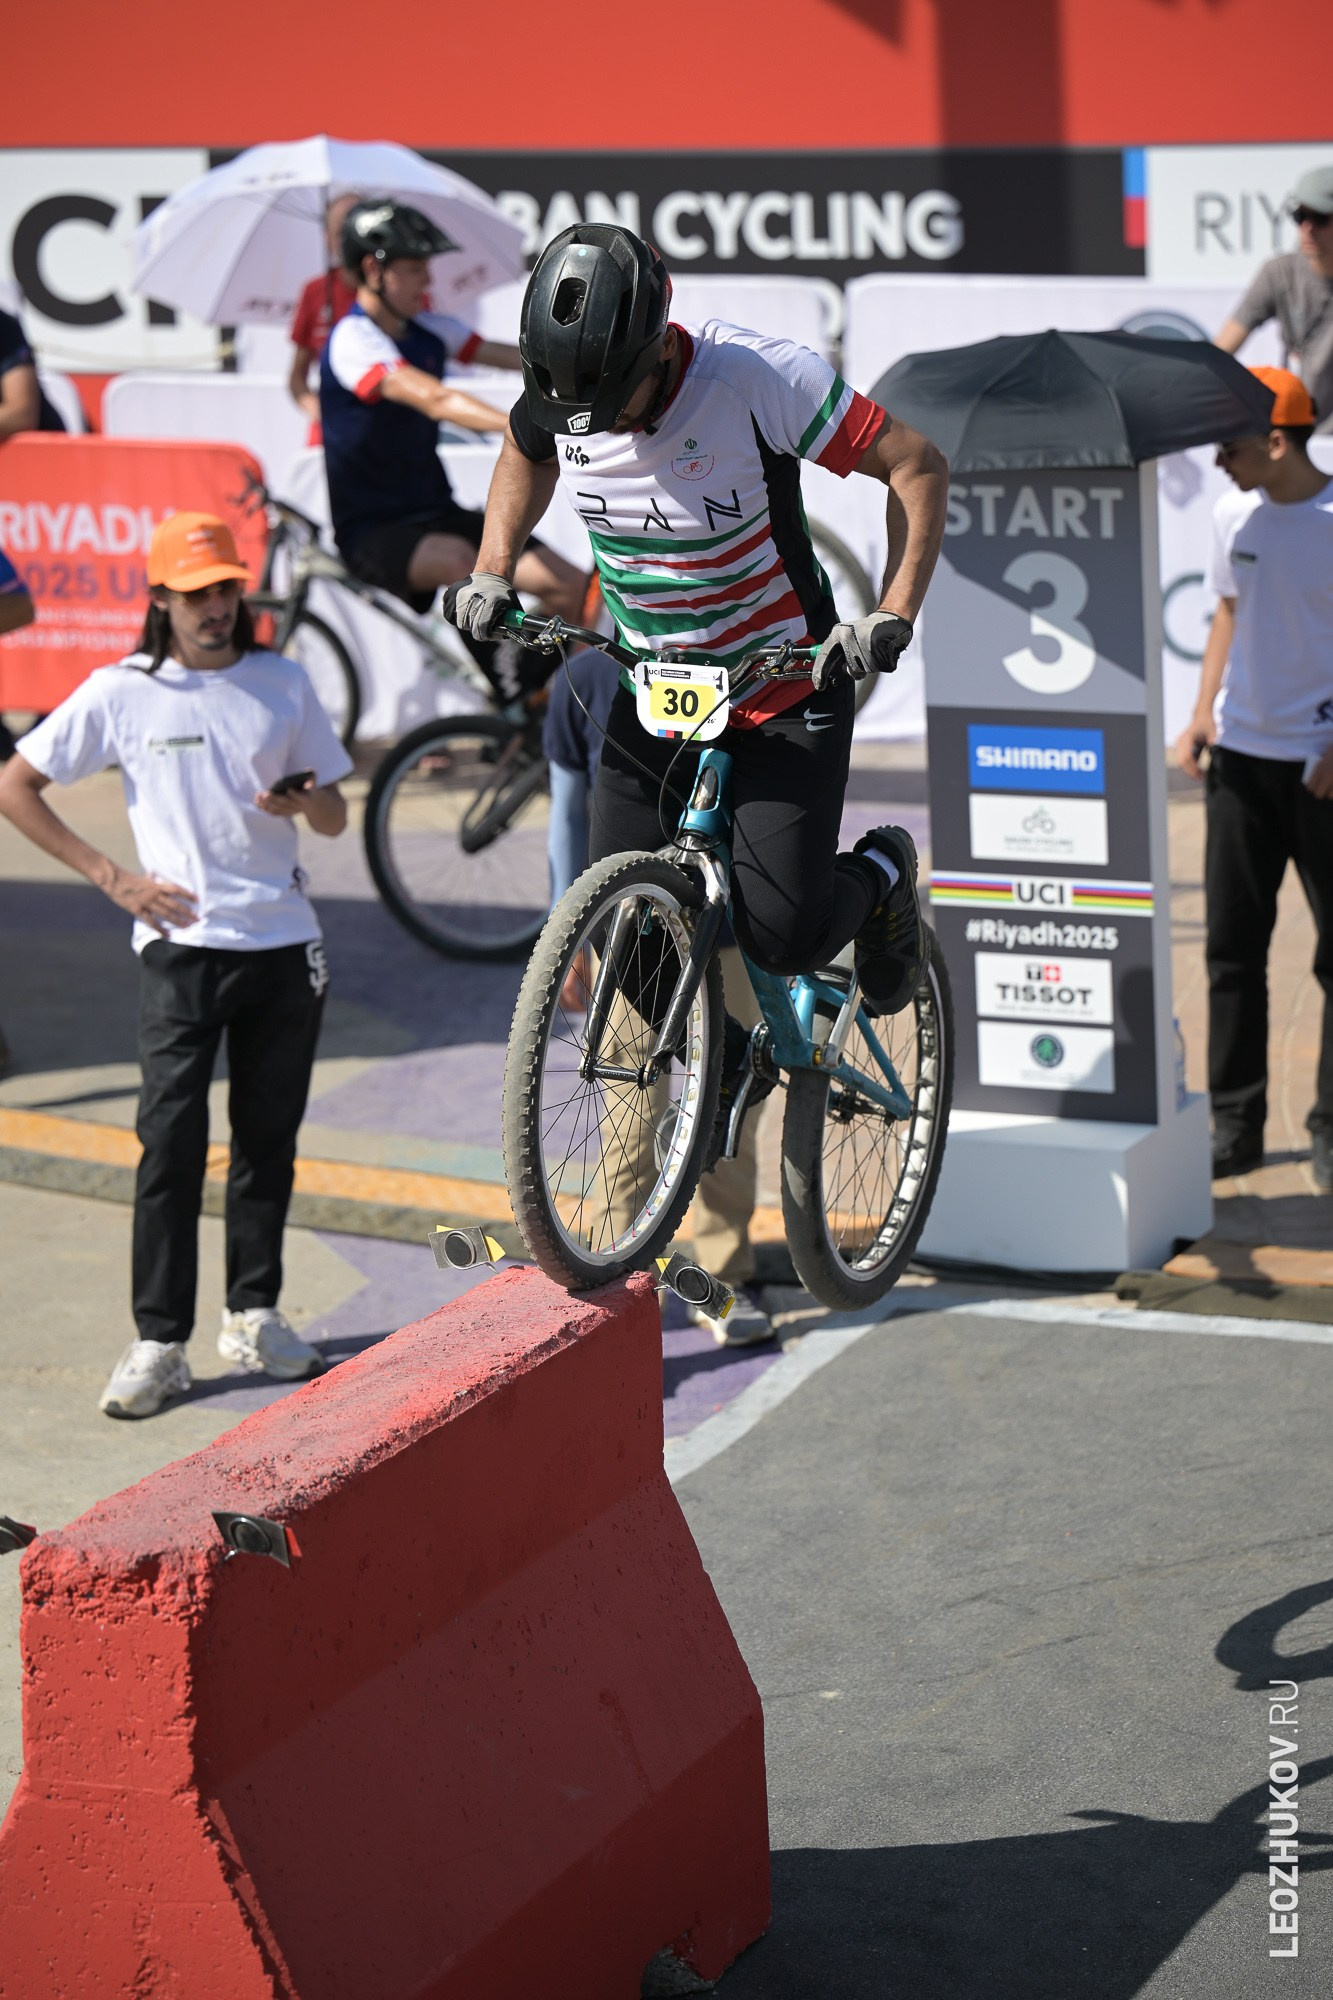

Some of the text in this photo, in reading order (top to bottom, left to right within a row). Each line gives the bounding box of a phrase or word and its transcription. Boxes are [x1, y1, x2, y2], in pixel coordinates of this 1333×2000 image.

[653, 189, 965, 261] CYCLING
[943, 485, 1124, 540] START
[20, 561, 98, 600] 025
[1001, 550, 1097, 694] 3
[663, 687, 699, 718] 30
[976, 745, 1098, 772] SHIMANO
[1015, 882, 1065, 906] UCI
[965, 918, 1119, 951] #Riyadh2025
[997, 984, 1092, 1005] TISSOT
